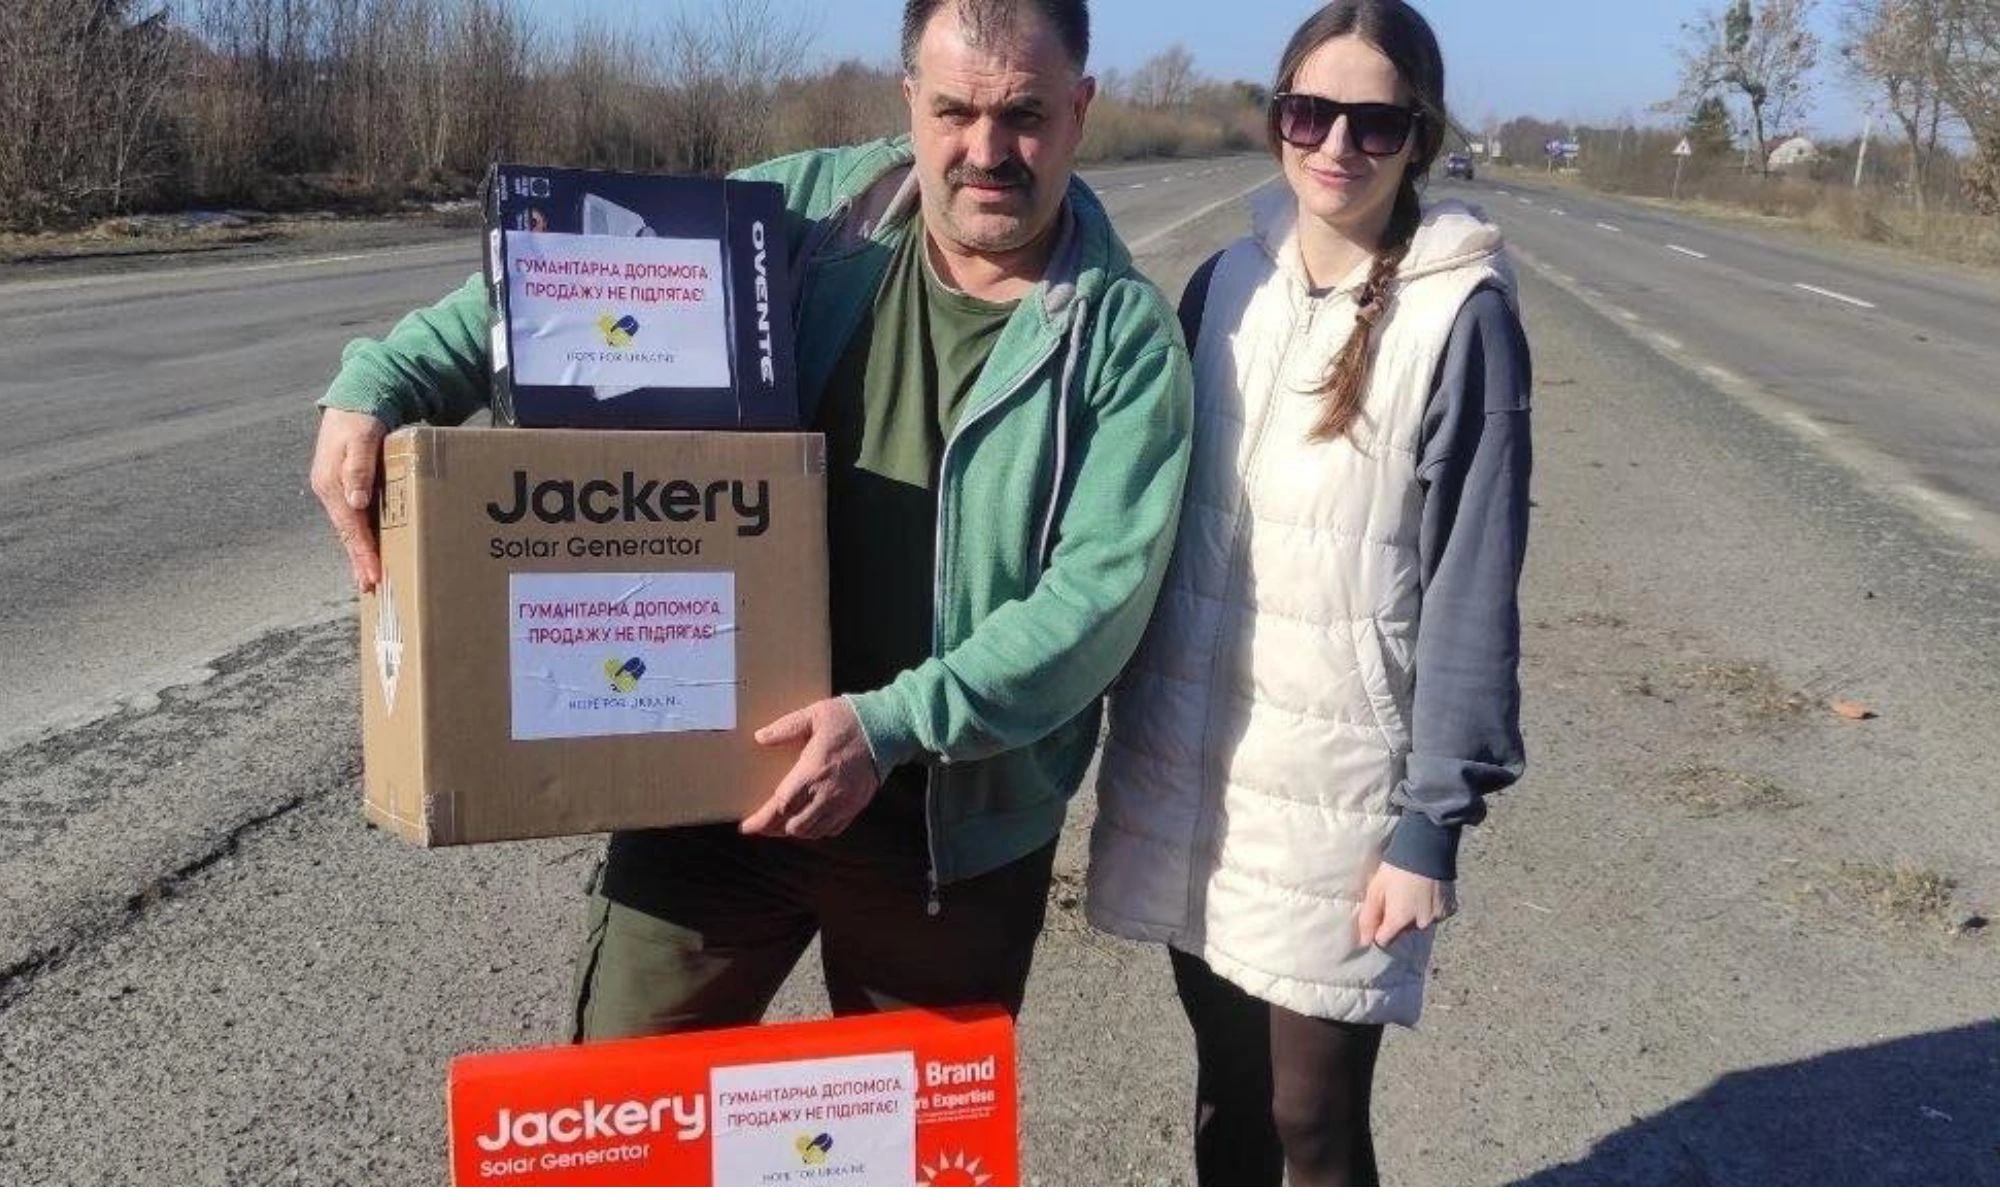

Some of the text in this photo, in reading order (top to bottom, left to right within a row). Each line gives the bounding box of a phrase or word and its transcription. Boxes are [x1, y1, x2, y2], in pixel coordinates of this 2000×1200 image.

[515, 258, 620, 277] ГУМАНІТАРНА
[526, 282, 602, 301] ПРОДАЖУ
[607, 286, 626, 300] НЕ
[752, 220, 775, 388] OVENTE
[486, 471, 770, 537] Jackery
[490, 535, 702, 559] Solar Generator
[519, 602, 630, 618] ГУМАНІТАРНА
[529, 627, 612, 646] ПРОДАЖУ
[615, 626, 634, 641] НЕ
[926, 1054, 995, 1087] Brand
[720, 1085, 818, 1107] ГУМАНІТАРНА
[932, 1089, 995, 1109] Expertise
[476, 1094, 705, 1151] Jackery
[727, 1108, 802, 1128] ПРОДАЖУ
[806, 1105, 824, 1120] НЕ
[480, 1144, 651, 1178] Solar Generator
